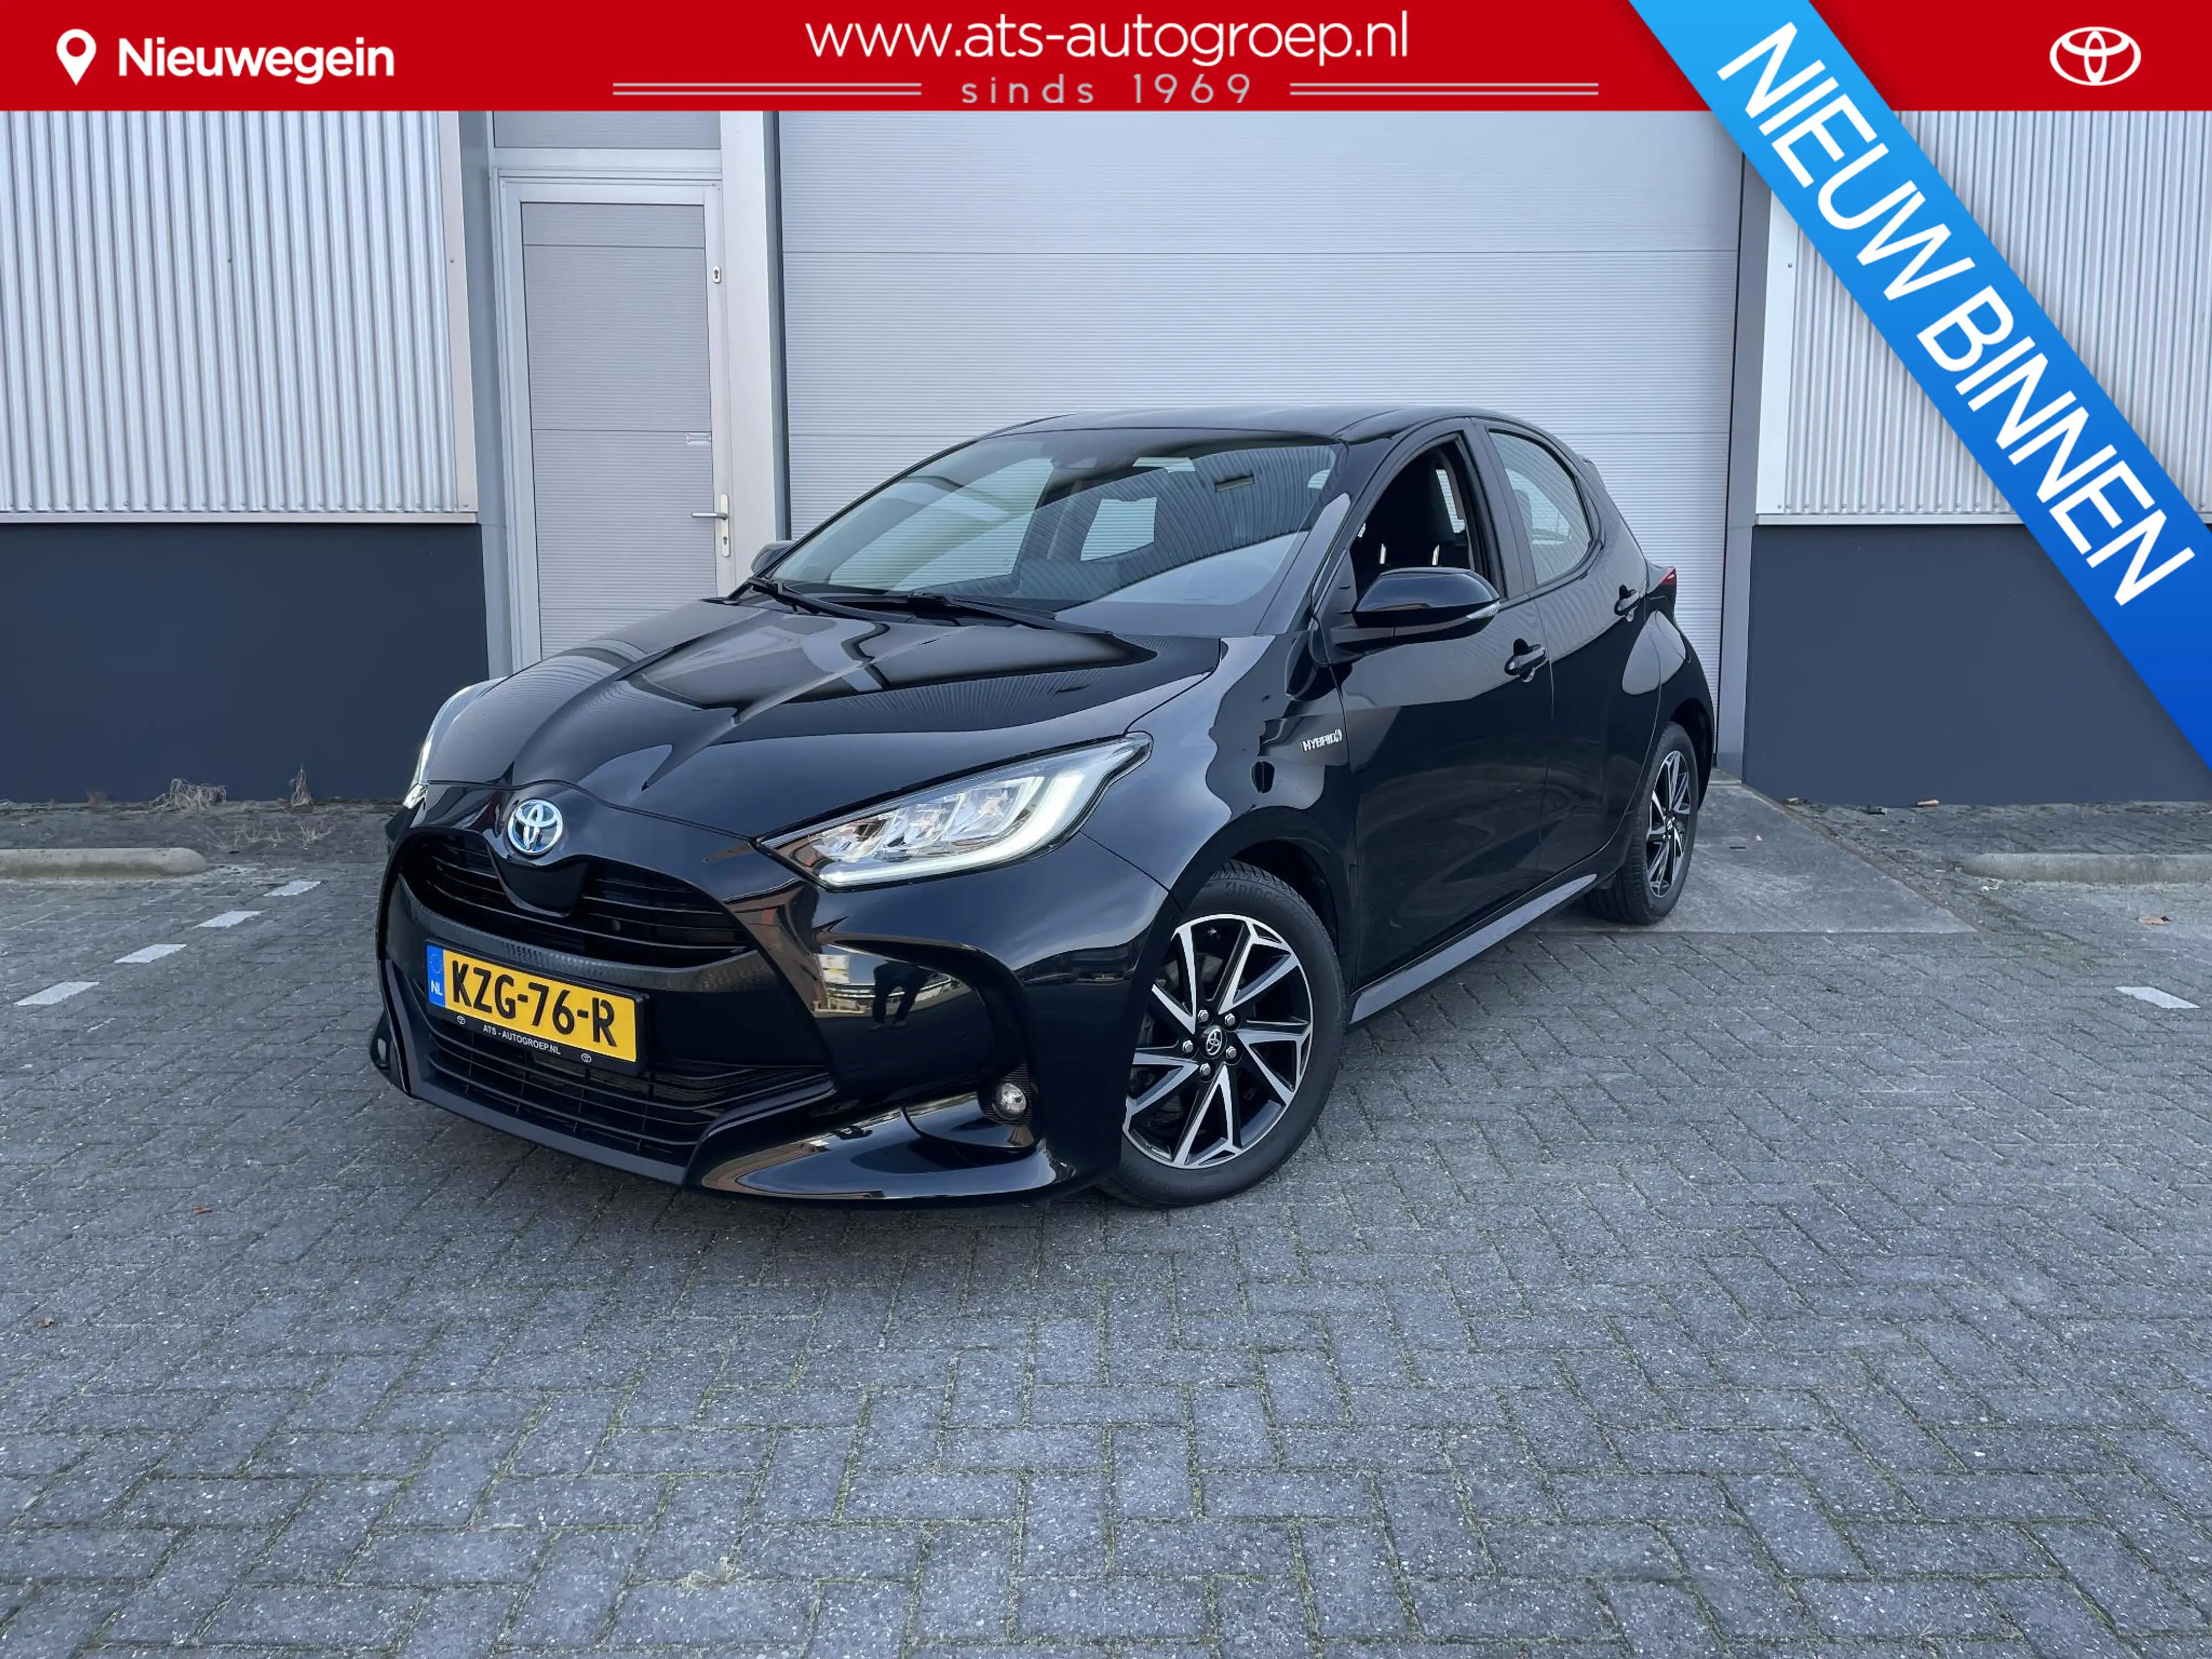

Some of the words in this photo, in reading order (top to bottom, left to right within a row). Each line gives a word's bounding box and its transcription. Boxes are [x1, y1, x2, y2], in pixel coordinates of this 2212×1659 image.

[1302, 733, 1336, 752] HYBRID
[431, 980, 443, 996] NL
[452, 960, 617, 1047] KZG-76-R
[483, 1024, 497, 1036] ATS
[502, 1031, 561, 1055] AUTOGROEP.NL
